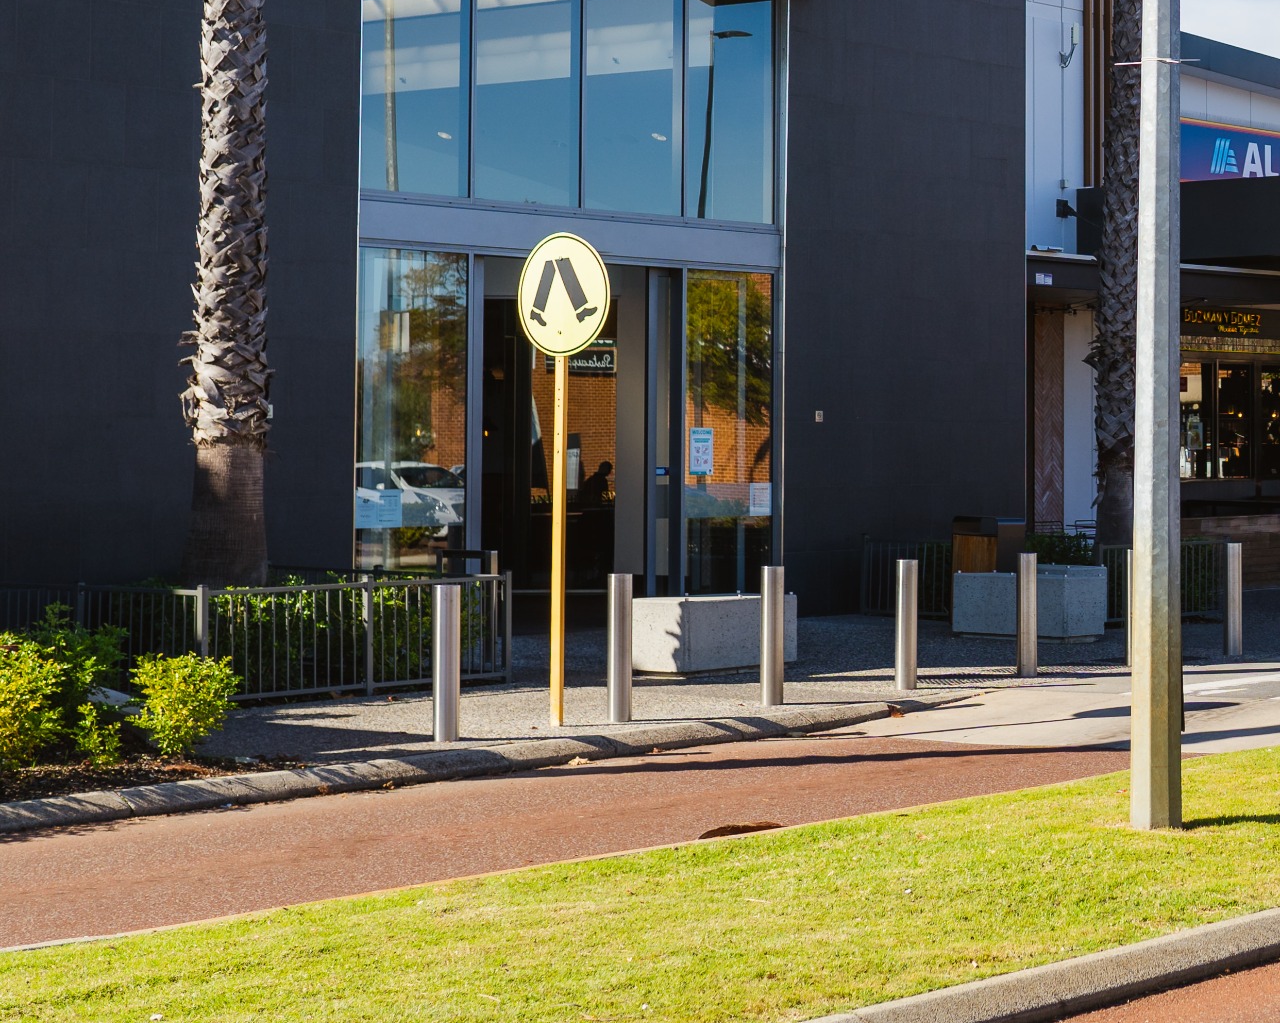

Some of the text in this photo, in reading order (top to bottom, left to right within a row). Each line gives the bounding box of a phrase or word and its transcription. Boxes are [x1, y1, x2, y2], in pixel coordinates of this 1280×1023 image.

[1184, 309, 1261, 327] GUZMAN Y GOMEZ
